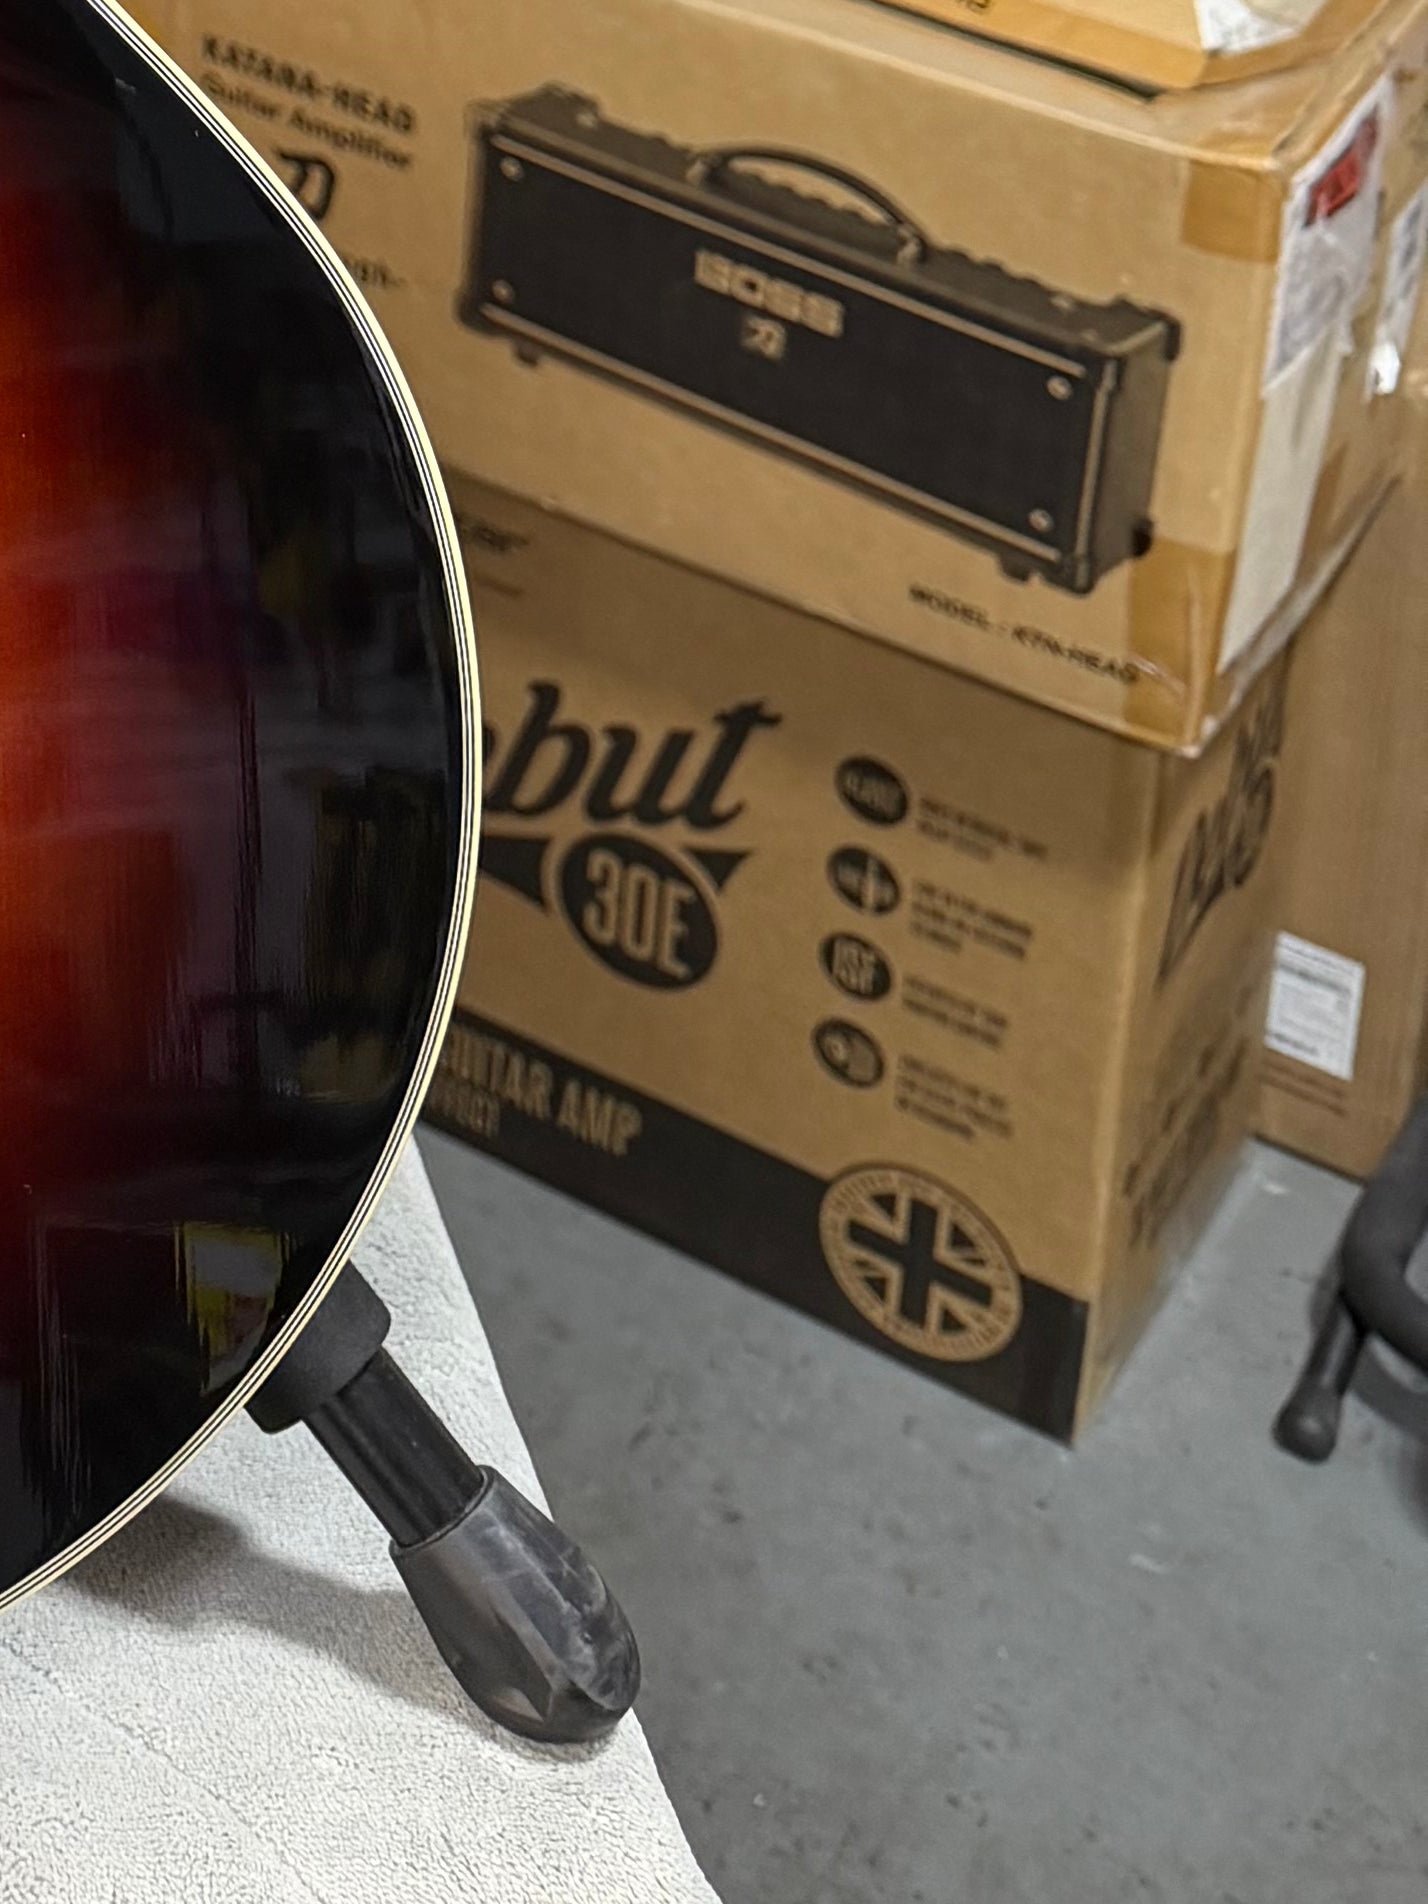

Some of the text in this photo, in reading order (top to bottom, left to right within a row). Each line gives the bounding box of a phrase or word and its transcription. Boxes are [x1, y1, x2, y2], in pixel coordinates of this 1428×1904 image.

[482, 677, 784, 833] but
[581, 845, 695, 982] 30E
[556, 1078, 644, 1157] AMP
